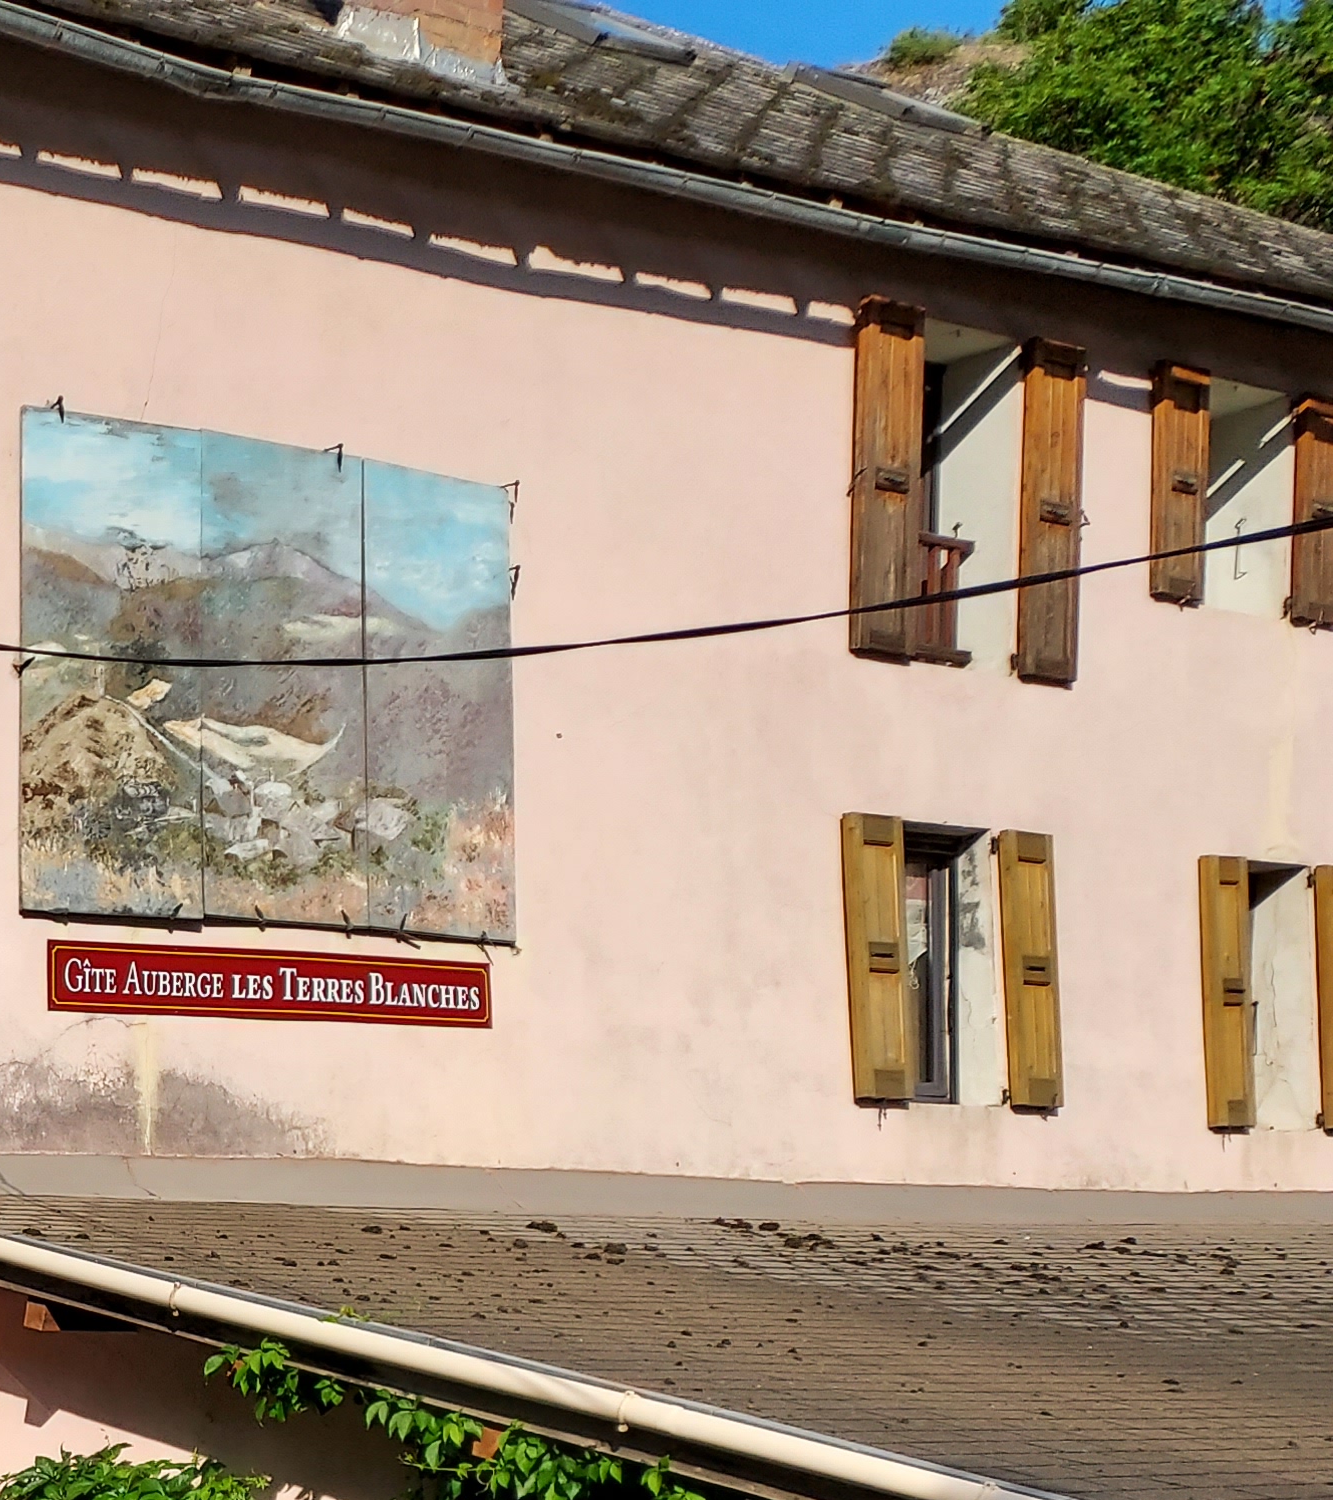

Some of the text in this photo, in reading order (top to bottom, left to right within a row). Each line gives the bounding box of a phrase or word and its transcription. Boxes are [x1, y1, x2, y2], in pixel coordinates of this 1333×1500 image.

[64, 957, 480, 1011] GÎTE AUBERGE LES TERRES BLANCHES
